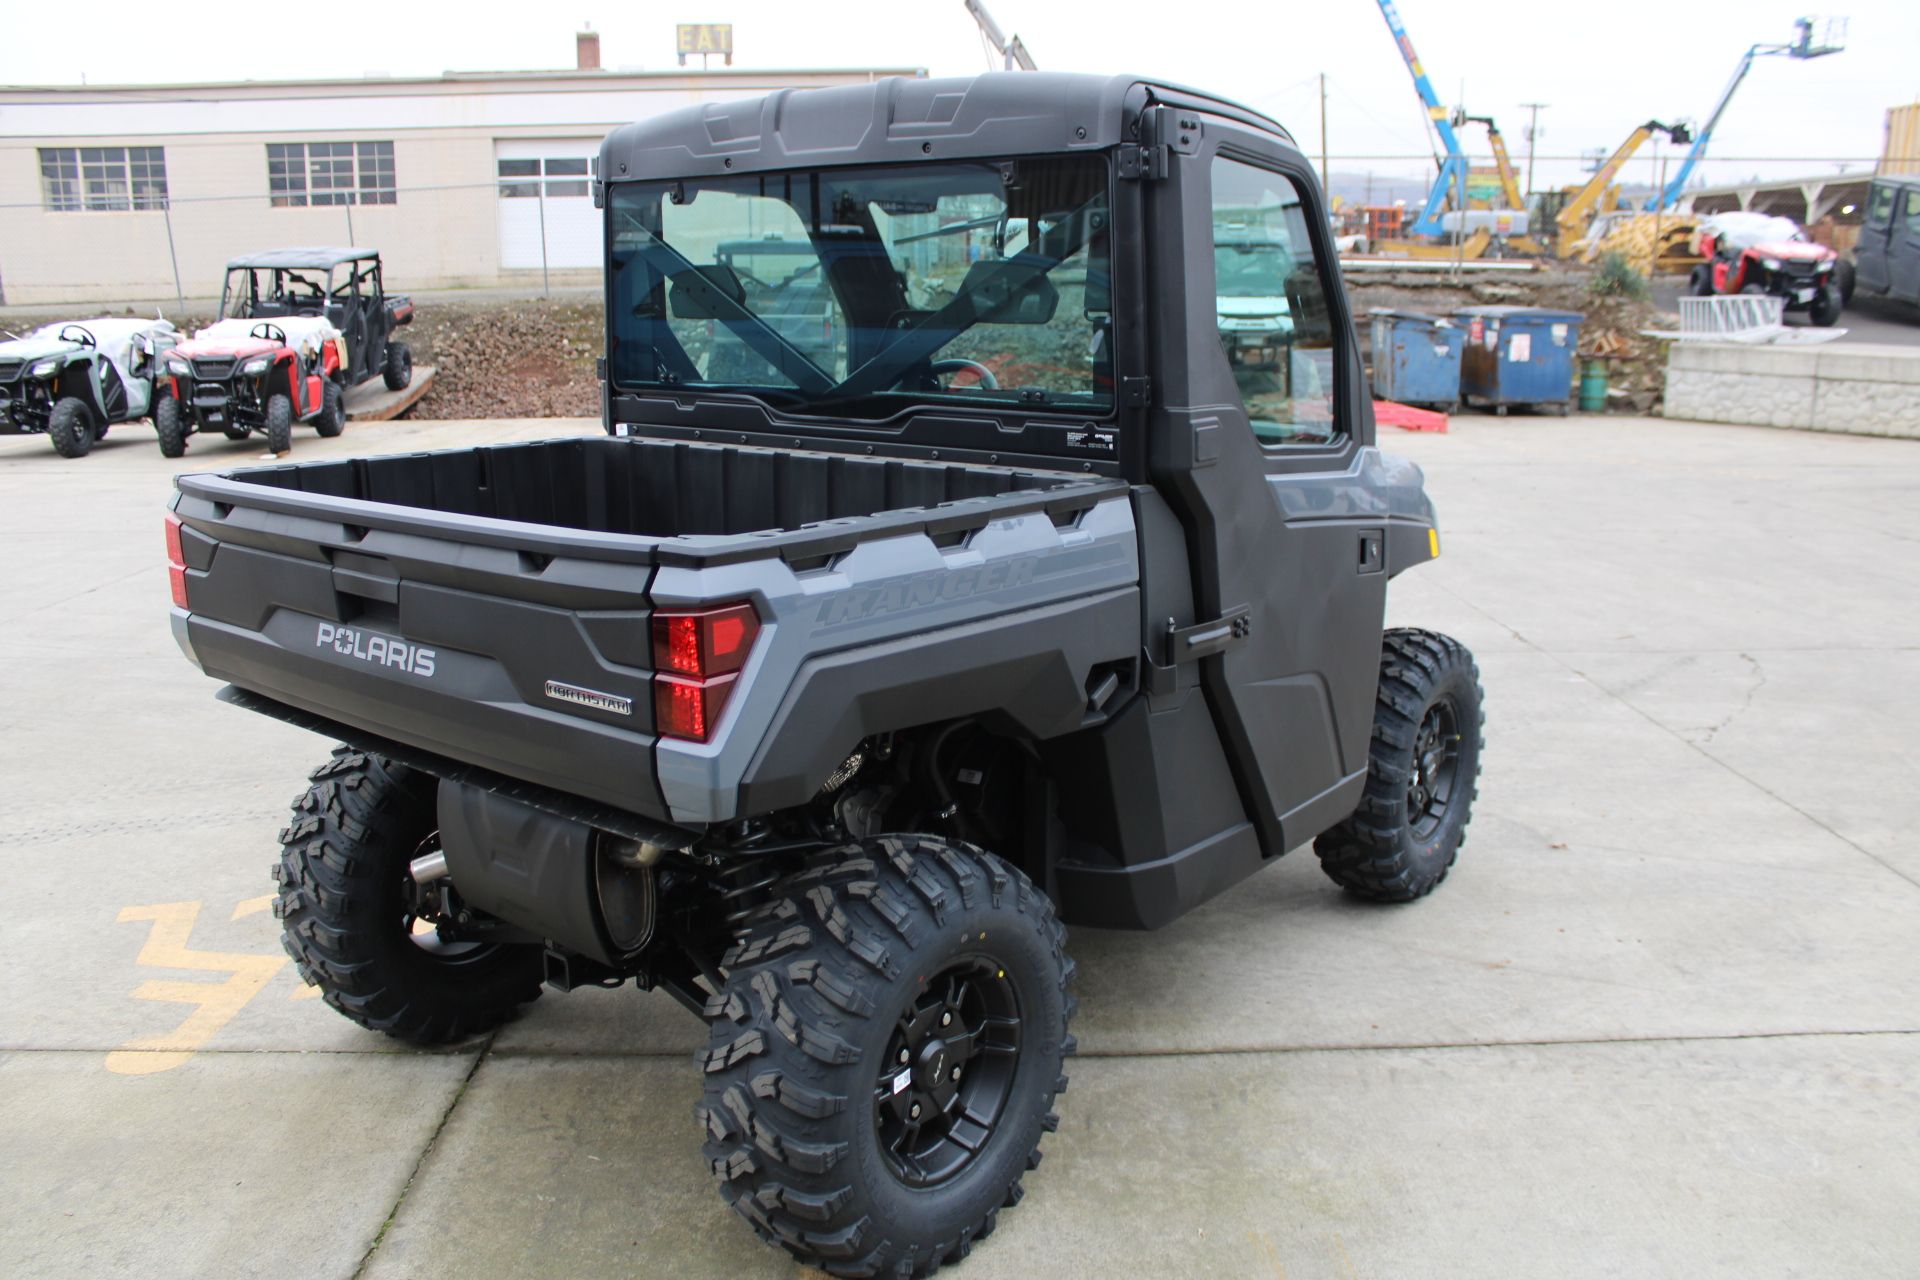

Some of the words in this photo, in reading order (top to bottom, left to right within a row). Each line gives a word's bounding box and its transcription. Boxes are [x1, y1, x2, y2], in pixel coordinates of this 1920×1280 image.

[679, 25, 730, 50] EAT
[822, 555, 1040, 627] RANGER
[316, 622, 436, 678] POLARIS
